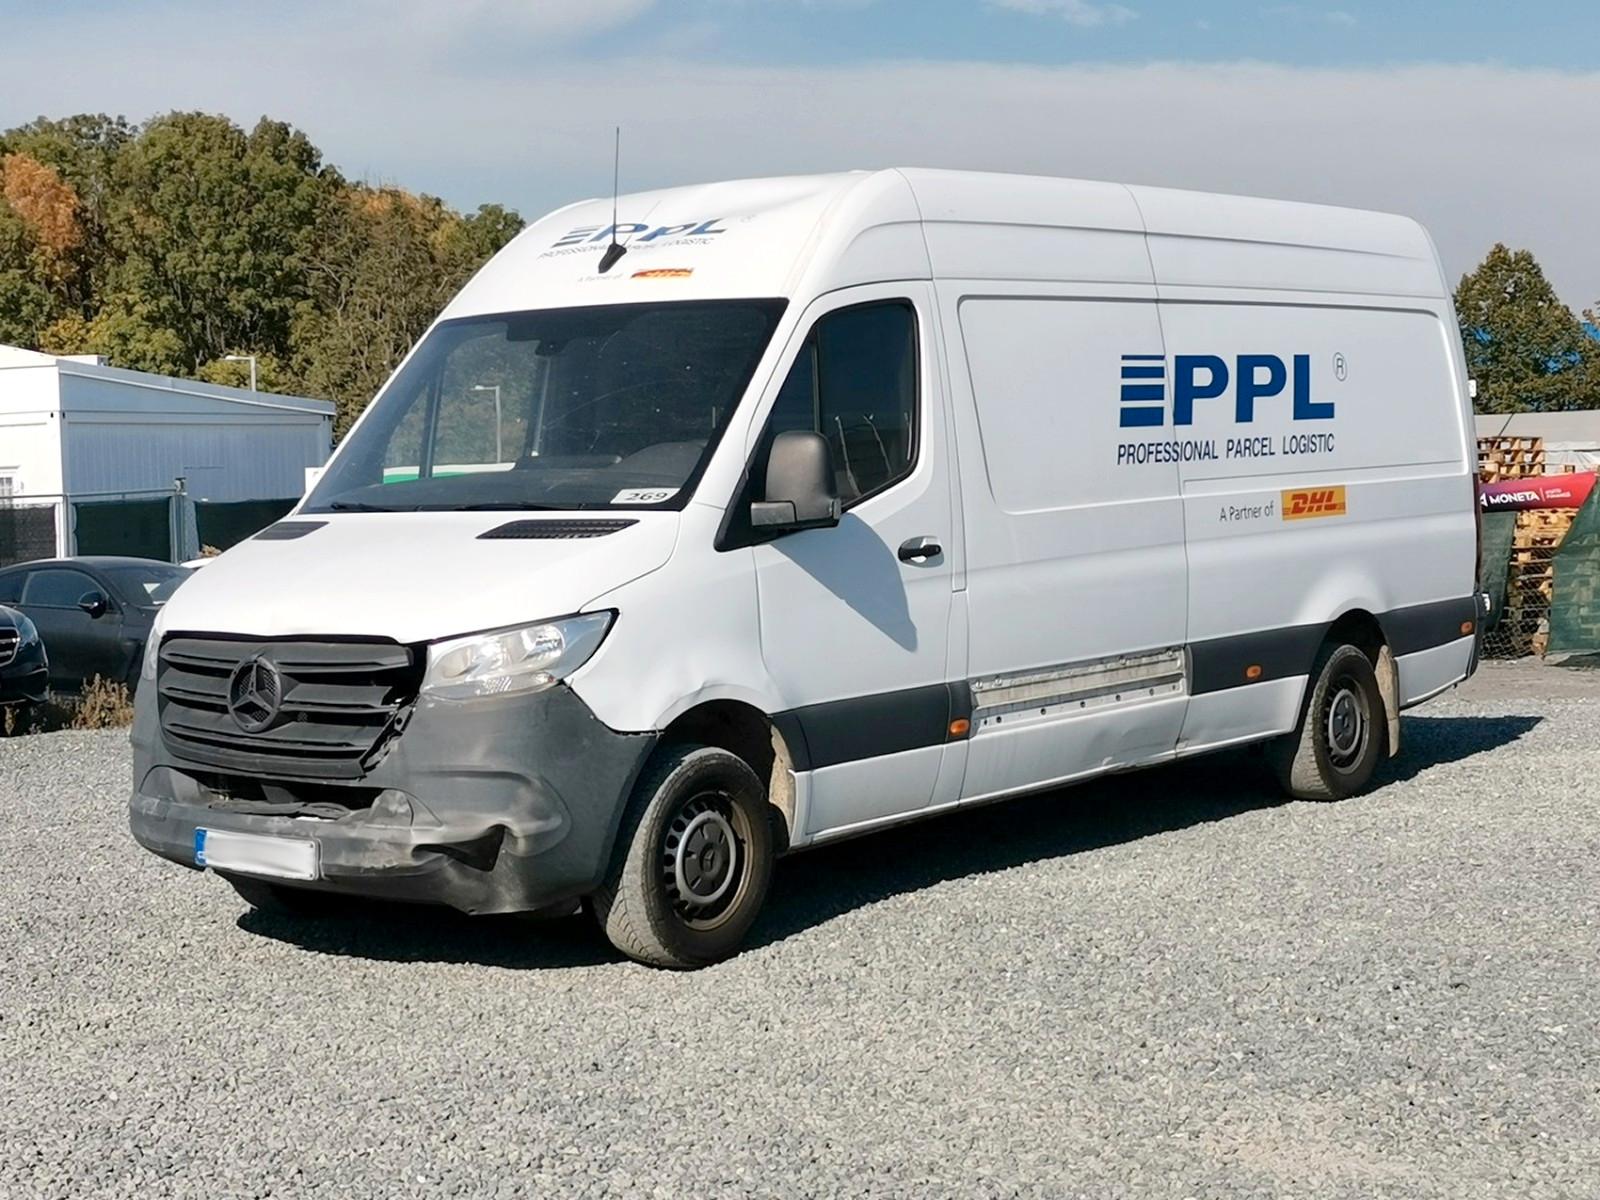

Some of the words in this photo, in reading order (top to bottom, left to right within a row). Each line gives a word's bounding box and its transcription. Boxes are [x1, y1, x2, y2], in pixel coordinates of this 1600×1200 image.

[1173, 354, 1335, 426] PPL
[1117, 440, 1219, 465] PROFESSIONAL
[1226, 437, 1276, 459] PARCEL
[1282, 433, 1335, 455] LOGISTIC
[625, 492, 668, 501] 269
[1290, 490, 1338, 514] DHL
[1489, 491, 1540, 504] MONETA
[1219, 507, 1228, 521] A
[1229, 502, 1262, 521] Partner
[1264, 501, 1274, 516] of
